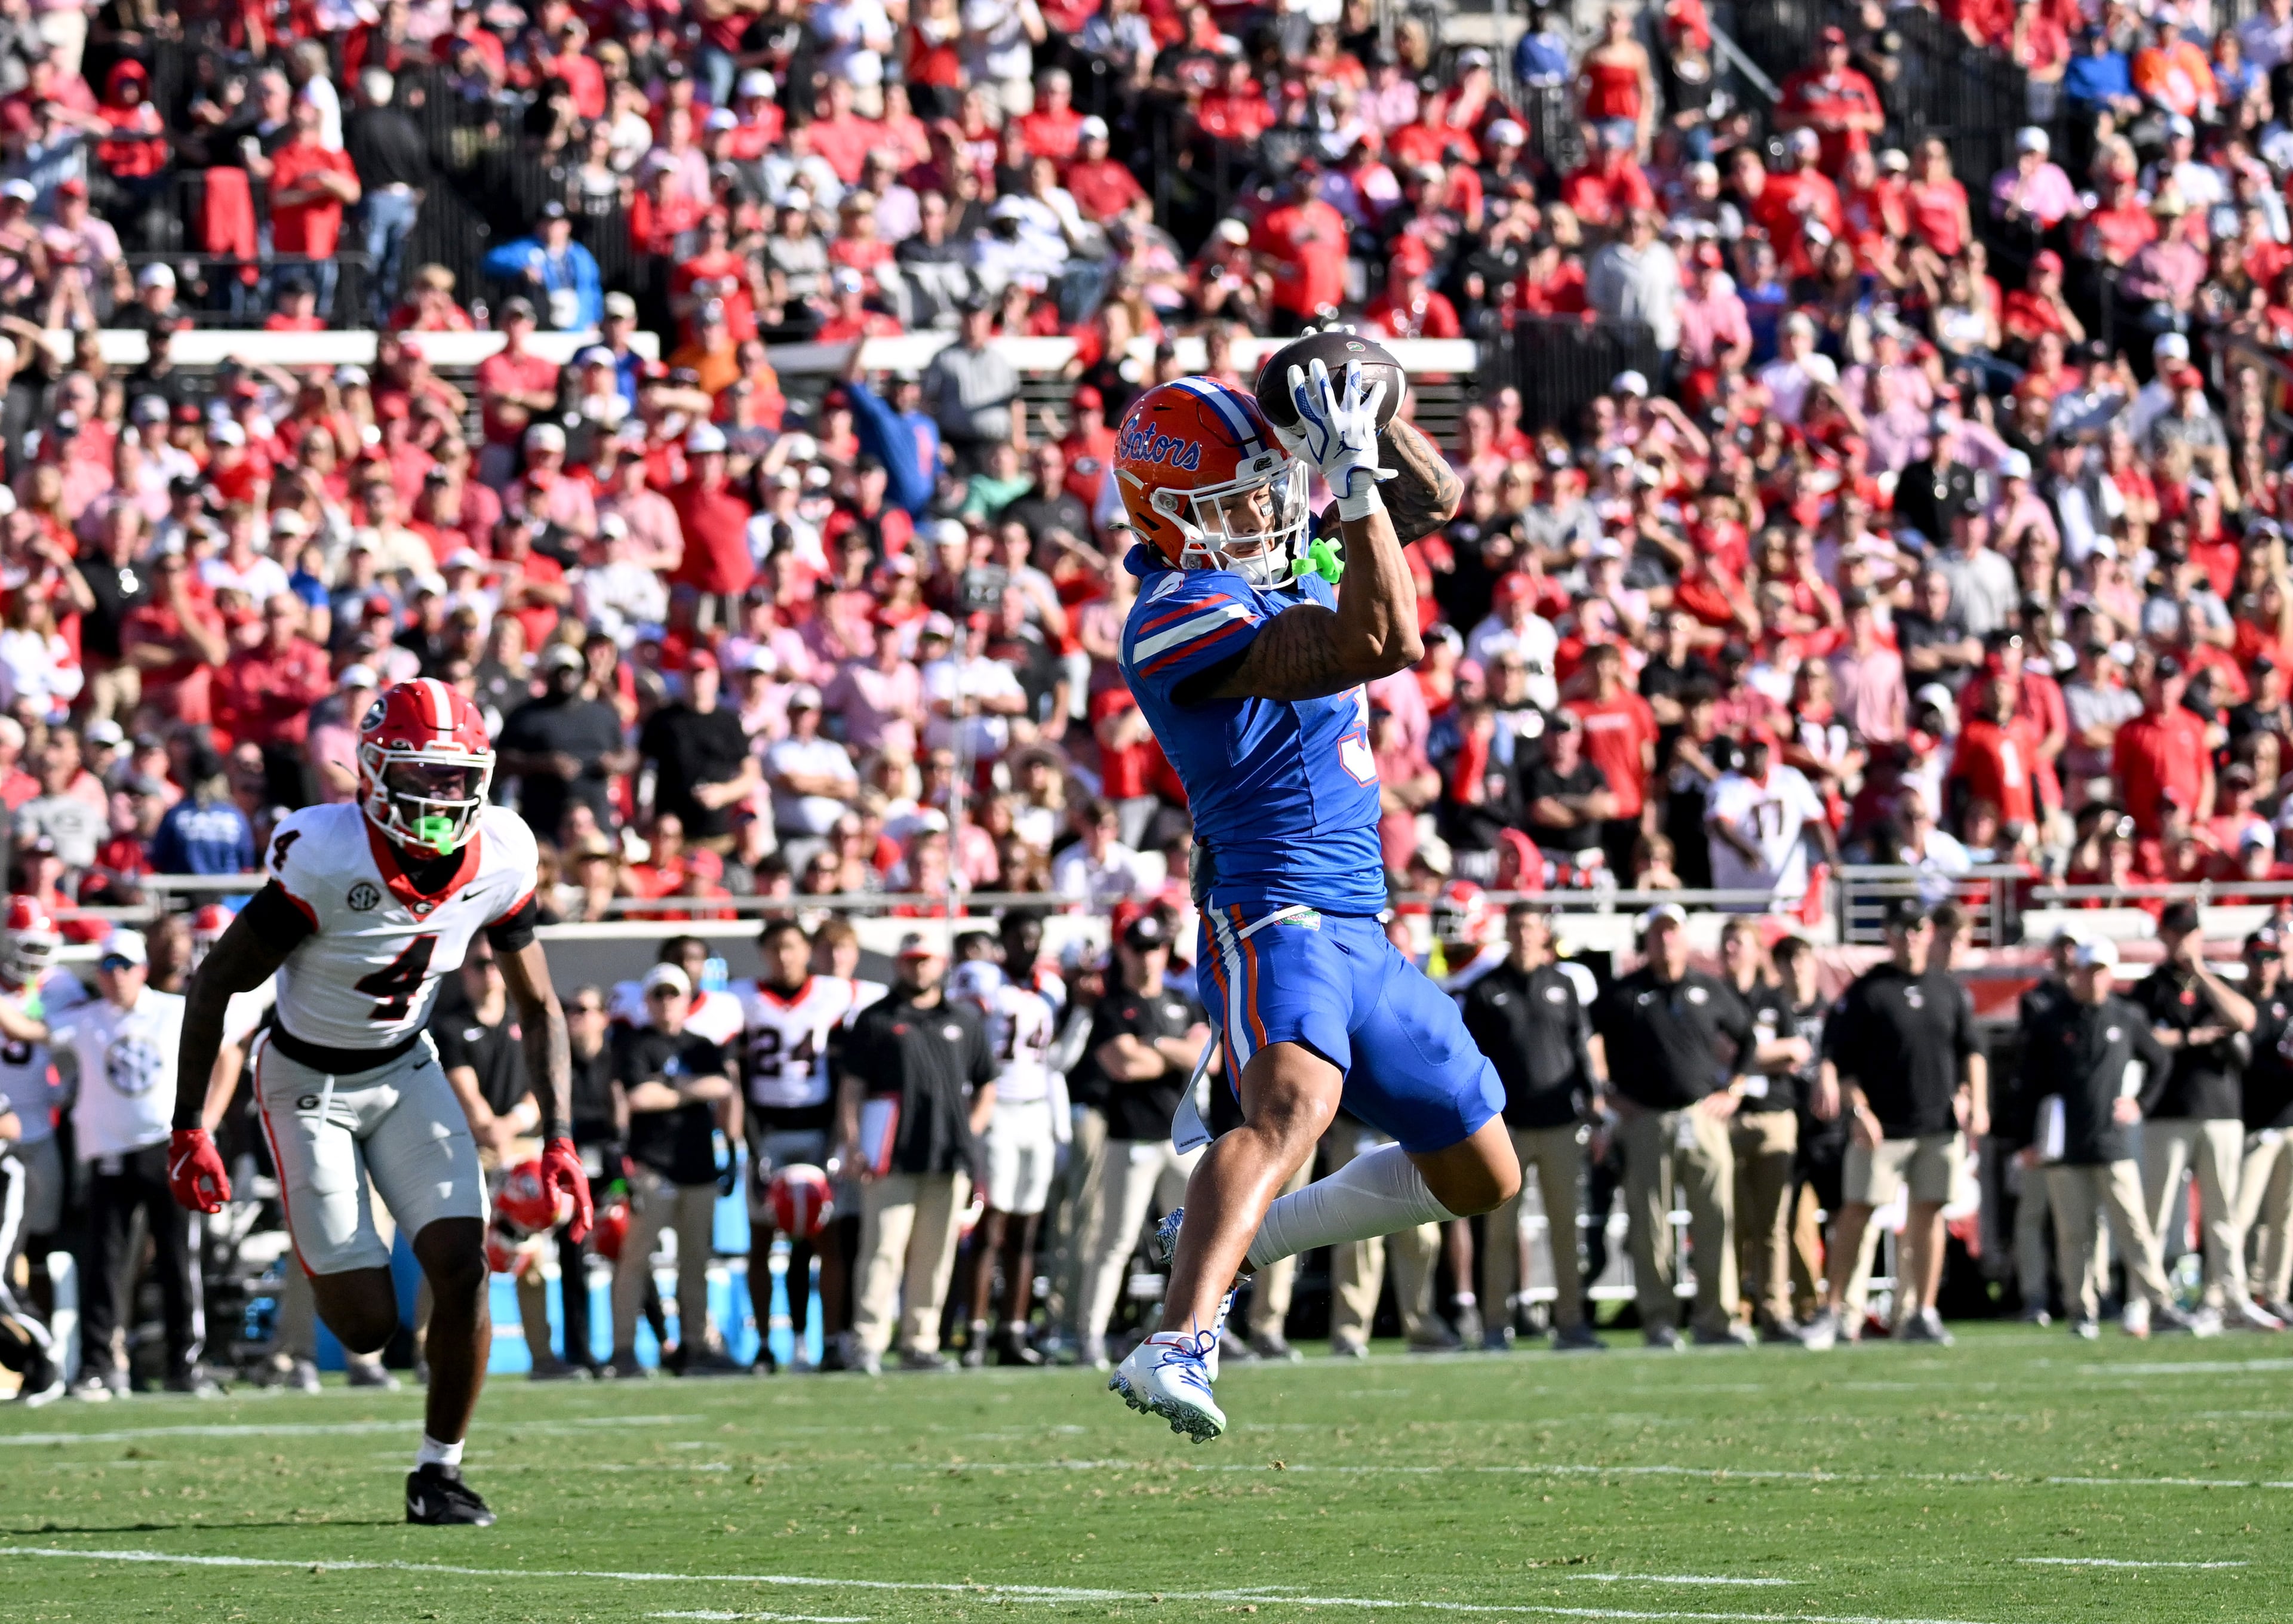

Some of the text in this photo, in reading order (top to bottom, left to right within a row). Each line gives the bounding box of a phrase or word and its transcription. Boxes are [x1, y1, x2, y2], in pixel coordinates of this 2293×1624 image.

[1120, 415, 1200, 471] Gators
[272, 829, 302, 872] 4
[348, 882, 381, 911] SEC
[354, 934, 438, 1021] 4
[754, 1026, 817, 1076] 24
[297, 1094, 320, 1110] G
